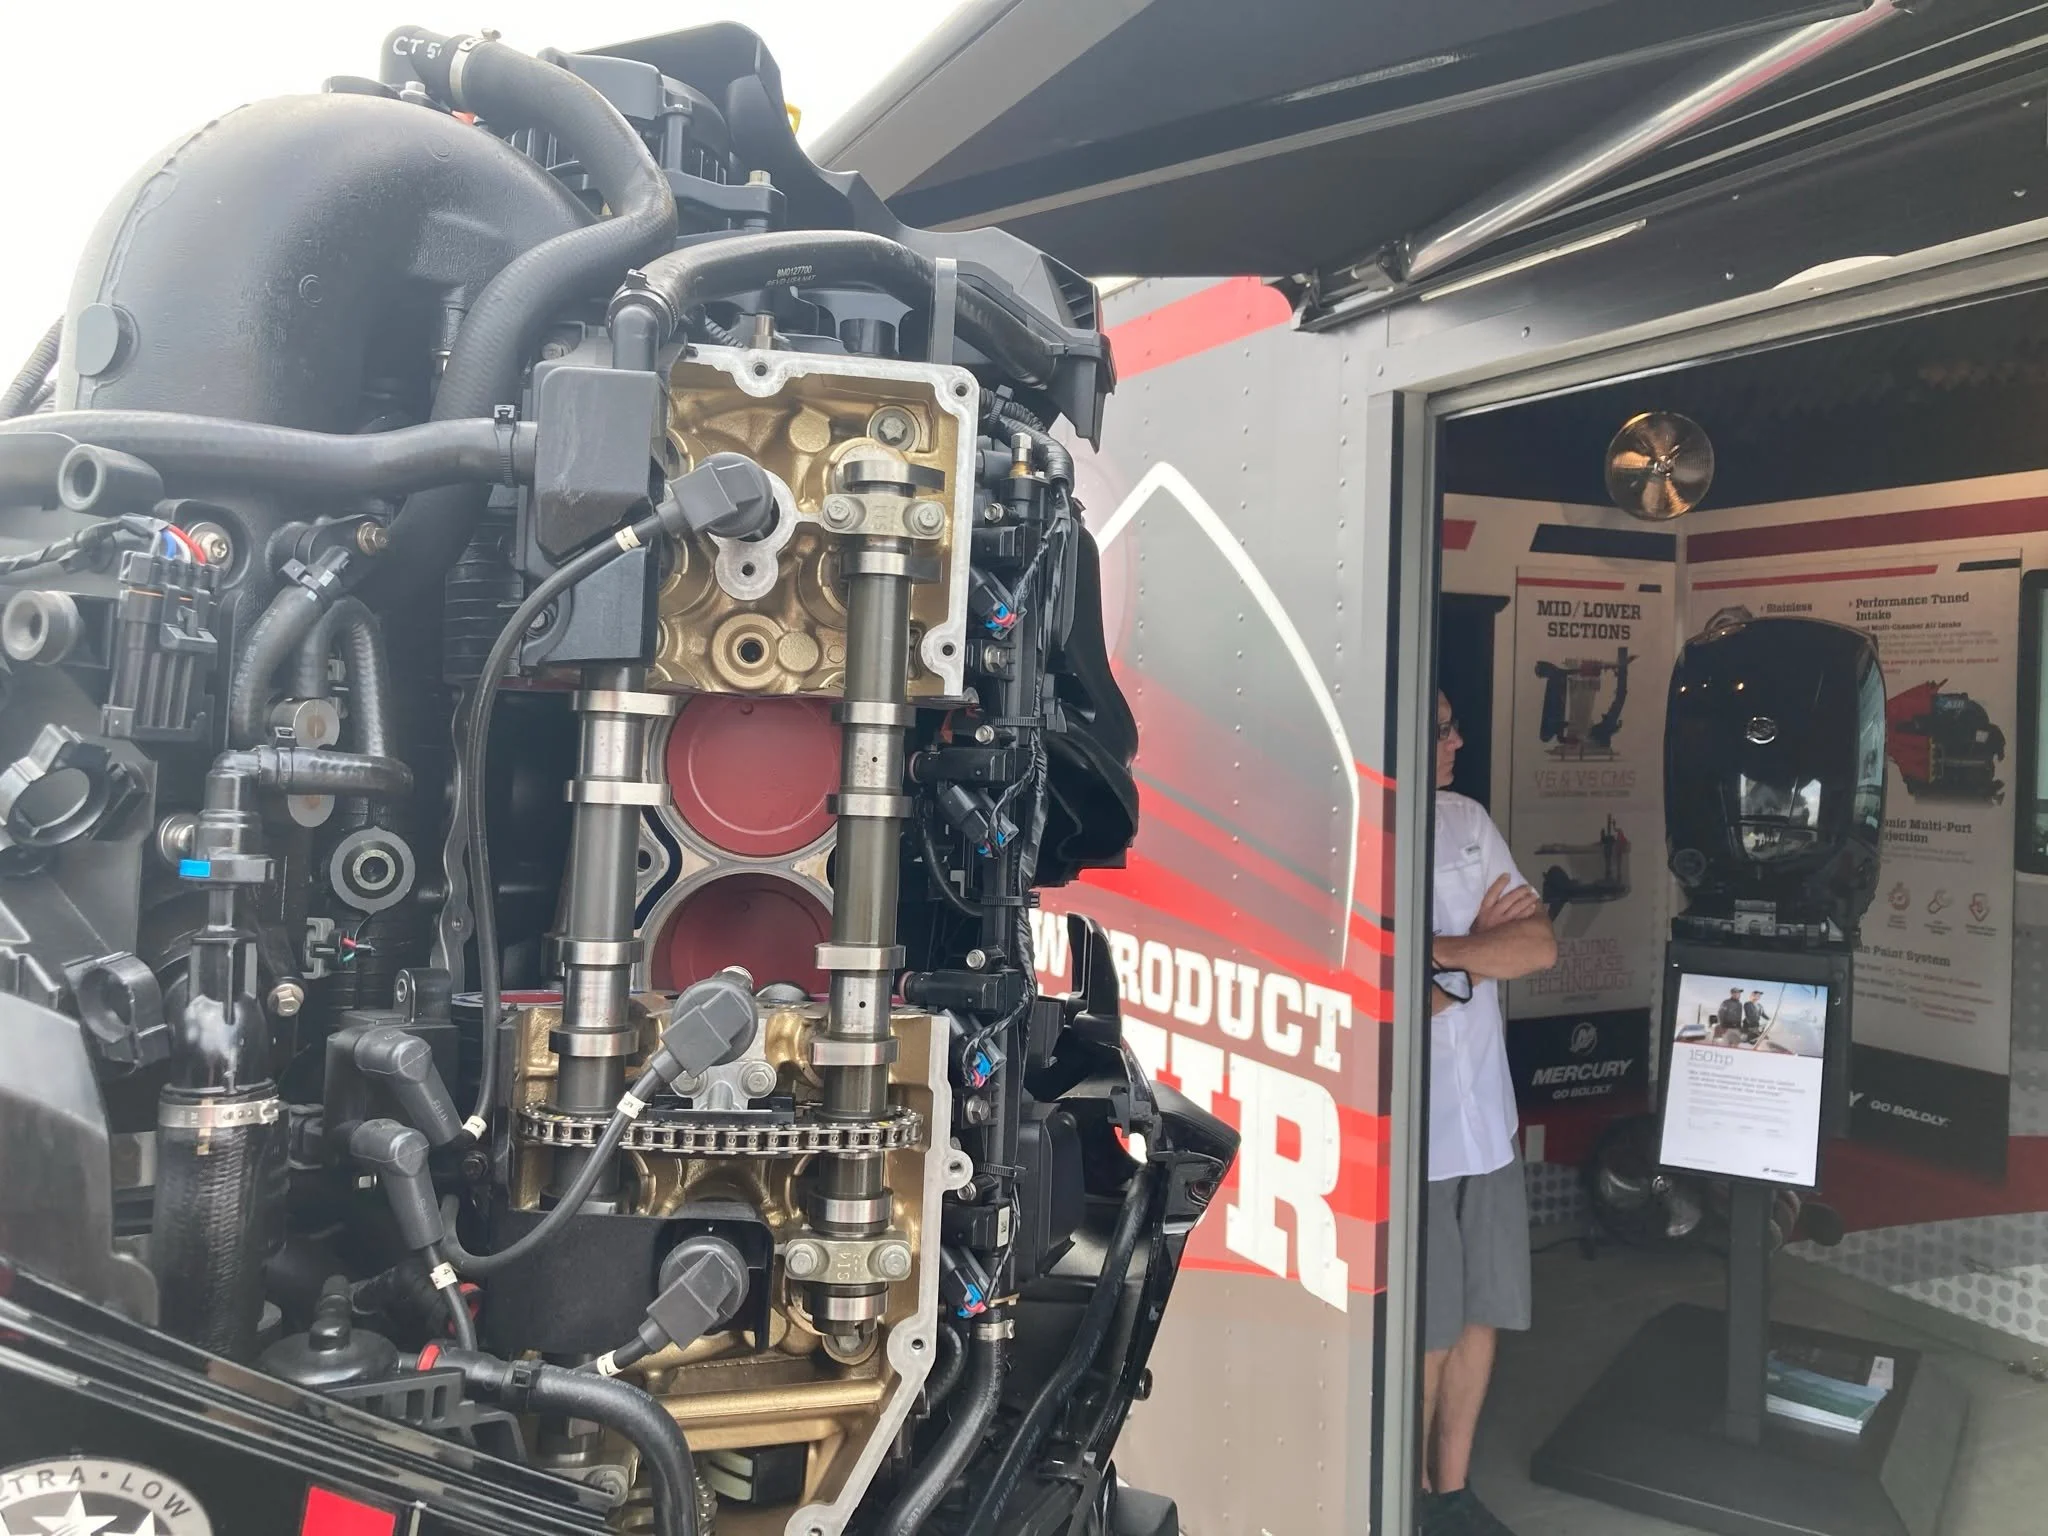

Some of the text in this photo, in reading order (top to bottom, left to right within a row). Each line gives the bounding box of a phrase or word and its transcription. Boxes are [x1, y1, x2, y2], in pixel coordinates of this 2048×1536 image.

[393, 36, 425, 56] CT
[1855, 592, 1970, 609] Performance Tuned
[1855, 610, 1892, 621] Intake
[1547, 621, 1631, 640] SECTIONS
[1910, 819, 1972, 833] Multi-Port
[1557, 938, 1618, 957] EADING
[1906, 950, 1951, 967] System
[1104, 928, 1352, 1072] RODUCT
[1531, 1058, 1634, 1086] MERCURY
[1552, 1089, 1570, 1100] GO
[0, 1465, 192, 1519] TRA LOW
